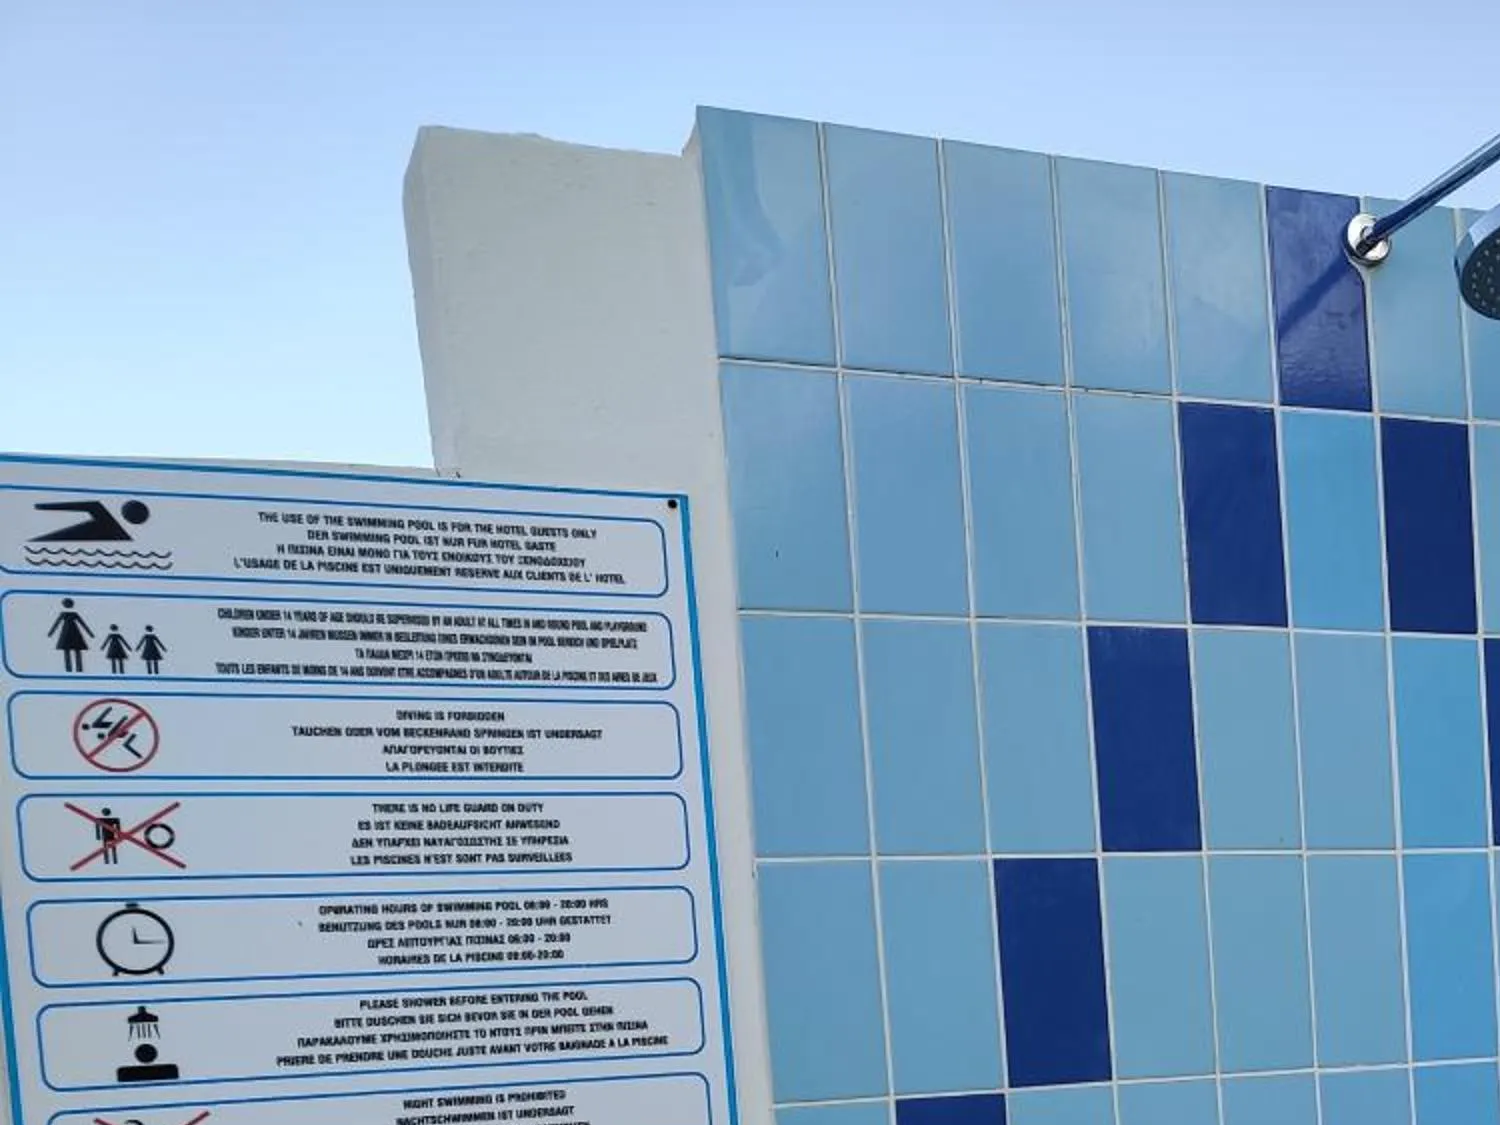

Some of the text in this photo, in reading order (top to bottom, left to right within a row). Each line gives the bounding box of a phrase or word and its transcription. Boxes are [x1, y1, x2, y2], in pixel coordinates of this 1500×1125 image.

[258, 512, 278, 524] THE
[282, 513, 303, 526] USE
[324, 516, 344, 527] THE
[347, 517, 405, 530] SWIMMING
[406, 520, 435, 531] POOL
[451, 522, 471, 533] FOR
[475, 523, 493, 534] THE
[496, 524, 528, 536] HOTEL
[530, 526, 569, 538] GUESTS
[571, 528, 597, 539] ONLY
[360, 992, 588, 1010] PLEASE SHOWER BEFORE ENTERING THE POOL
